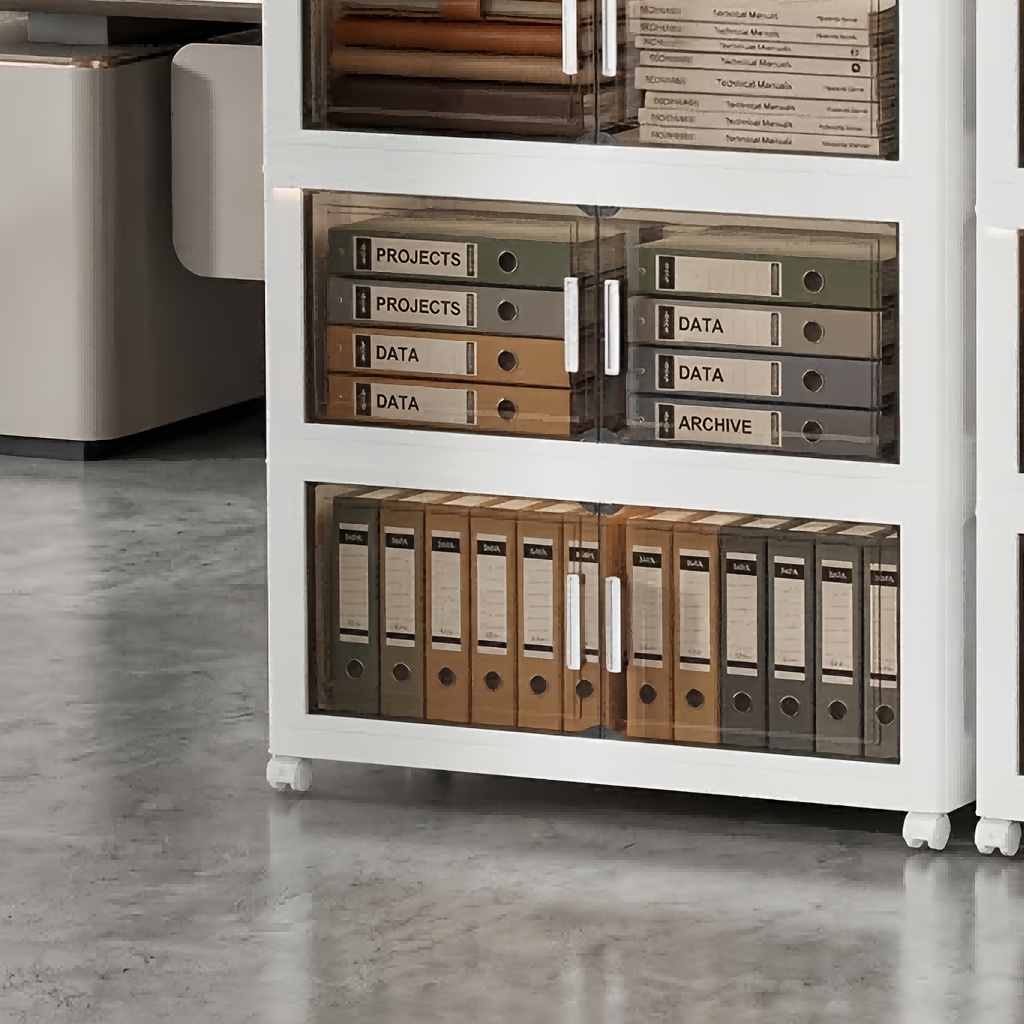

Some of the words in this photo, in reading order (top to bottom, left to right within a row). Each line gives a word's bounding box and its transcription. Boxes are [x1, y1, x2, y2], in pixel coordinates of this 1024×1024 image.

[376, 247, 461, 267] PROJECTS
[376, 296, 461, 316] PROJECTS
[678, 316, 724, 334] DATA
[376, 345, 419, 363] DATA
[678, 365, 724, 383] DATA
[376, 393, 419, 411] DATA
[678, 415, 753, 435] ARCHIVE
